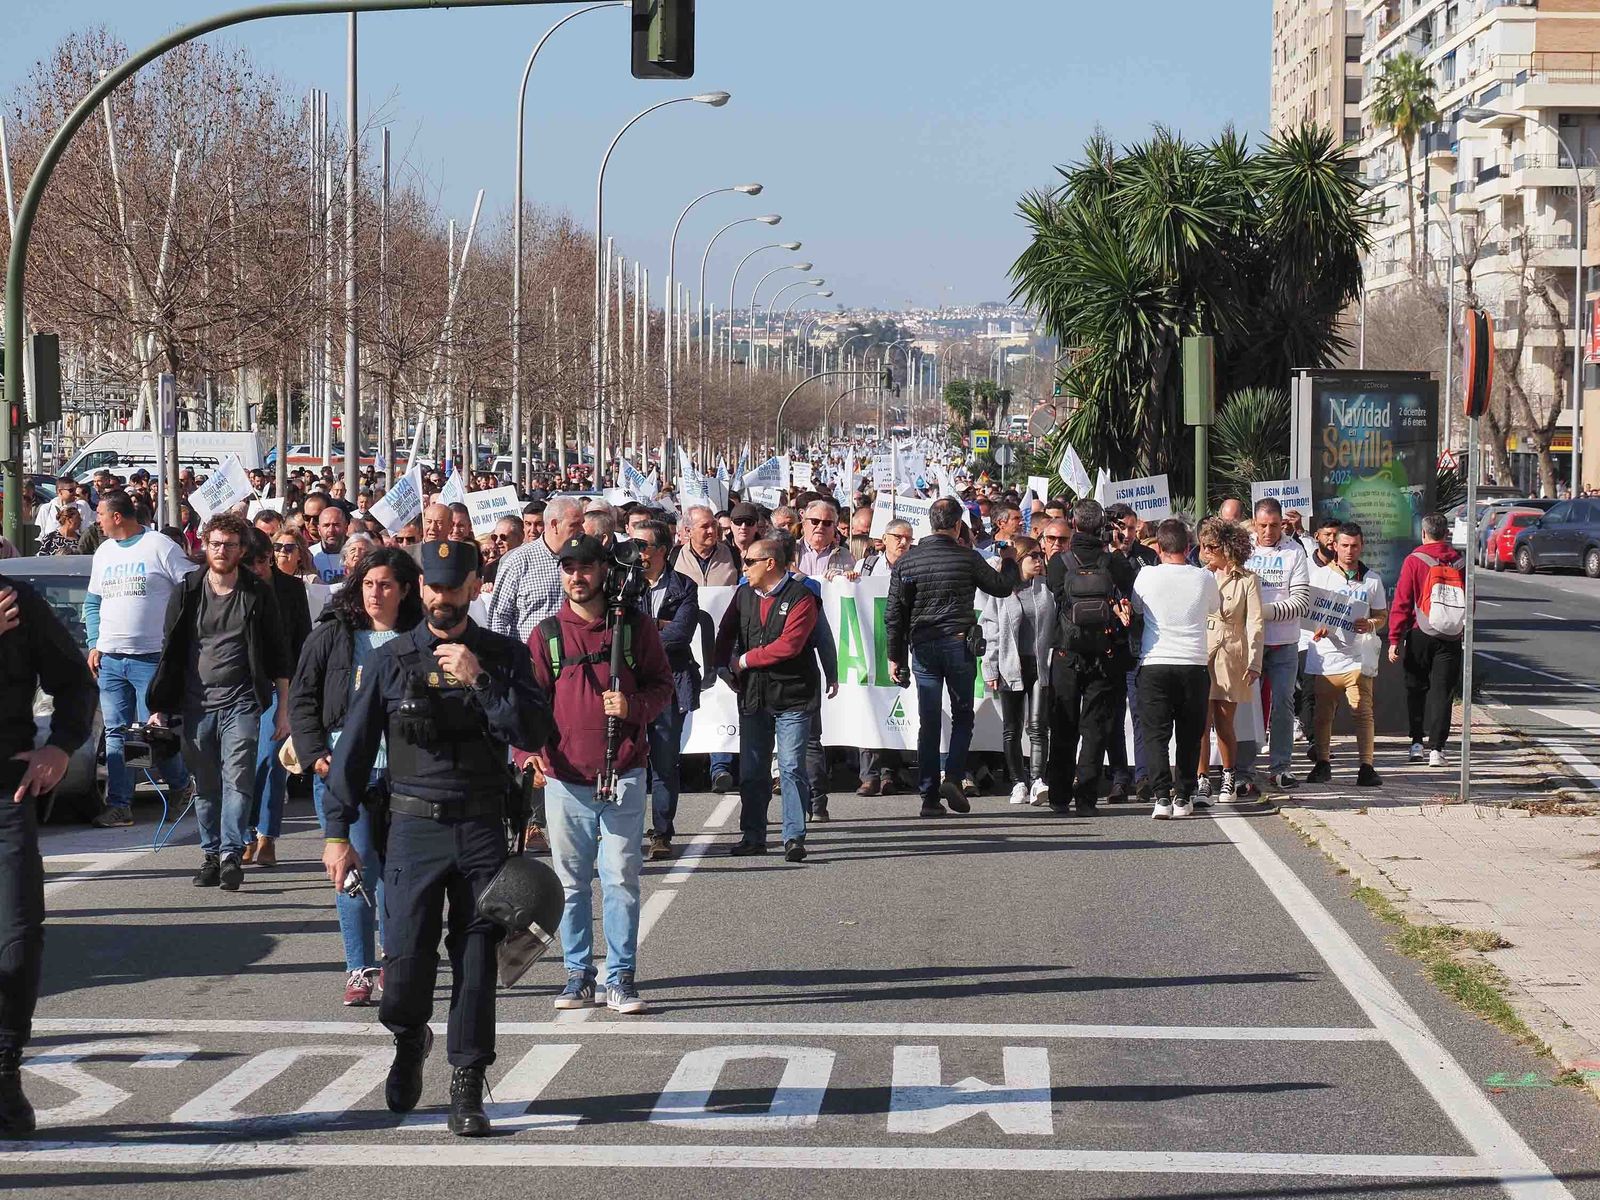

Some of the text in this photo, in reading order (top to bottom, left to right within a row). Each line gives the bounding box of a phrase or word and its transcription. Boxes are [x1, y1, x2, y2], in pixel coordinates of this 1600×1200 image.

[1328, 397, 1391, 429] Navidad
[1399, 407, 1427, 417] 2 diciembre
[1408, 417, 1413, 426] 6
[1322, 426, 1393, 469] Sevilla
[623, 467, 646, 487] AGUA
[1330, 470, 1351, 484] 2023
[1135, 485, 1156, 497] AGUA
[1281, 486, 1300, 496] AGUA
[491, 497, 508, 507] AGUA
[1135, 497, 1168, 511] FUTURO!!
[1280, 497, 1310, 508] FUTURO!!
[471, 515, 481, 526] NO
[481, 512, 493, 524] HAY
[104, 562, 146, 580] AGUA
[1331, 602, 1352, 617] AGUA
[1310, 610, 1326, 623] HAY
[885, 718, 911, 726] ASAJA
